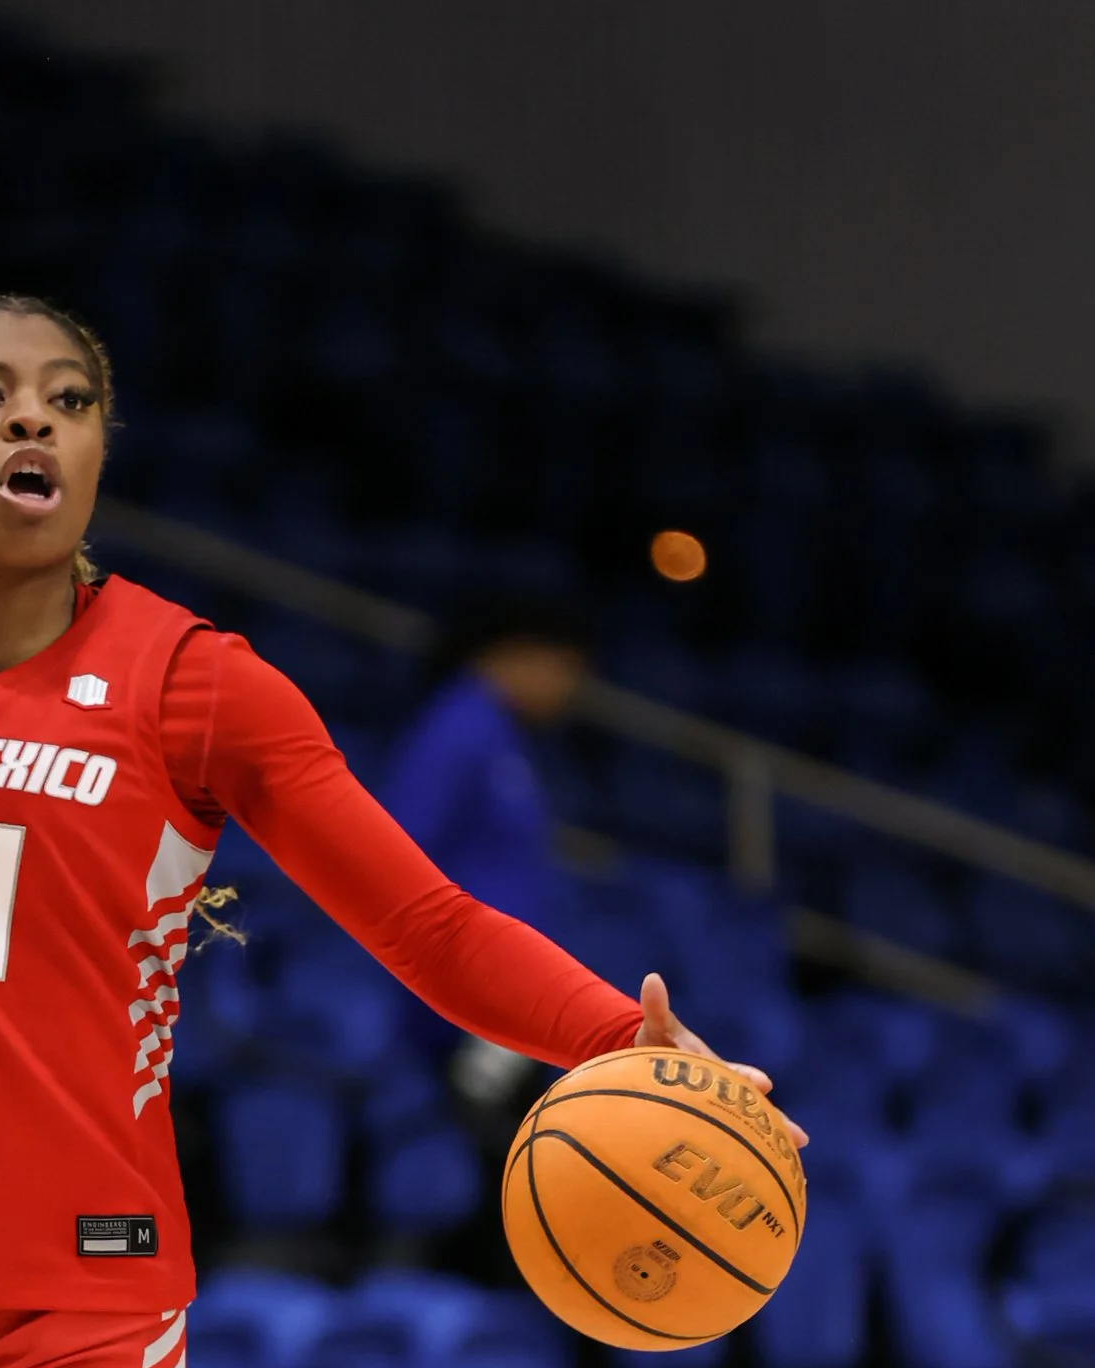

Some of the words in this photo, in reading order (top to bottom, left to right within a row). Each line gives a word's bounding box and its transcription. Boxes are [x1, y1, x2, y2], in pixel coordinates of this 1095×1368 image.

[652, 1141, 765, 1230] EVO
[762, 1211, 785, 1238] NXT
[138, 1228, 150, 1244] M
